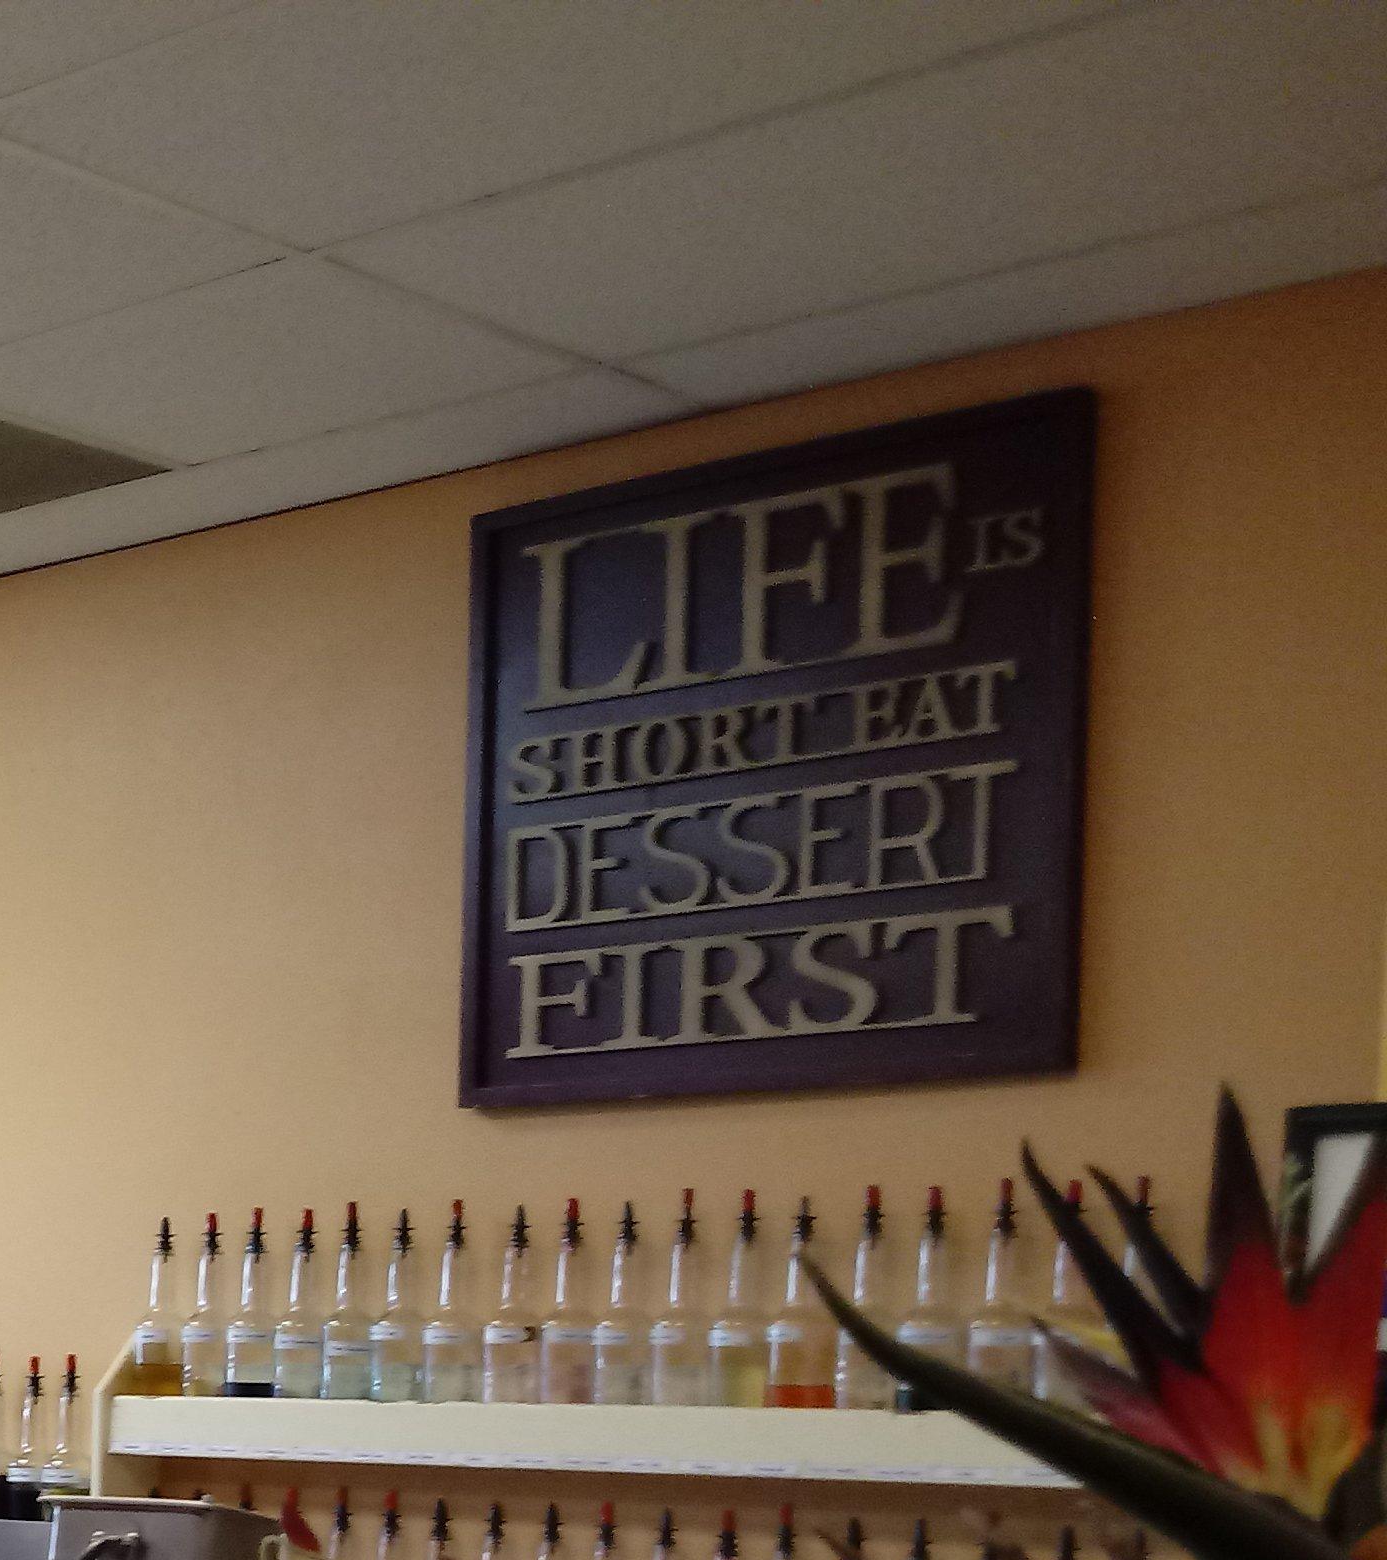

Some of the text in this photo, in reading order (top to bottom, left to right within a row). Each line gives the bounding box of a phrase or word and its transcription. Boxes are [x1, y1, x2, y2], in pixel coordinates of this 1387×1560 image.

[523, 462, 1047, 712] LIFE IS
[511, 660, 1017, 805] SHORT EAT
[505, 758, 1019, 933] DESSERT
[504, 904, 1017, 1059] FIRST
